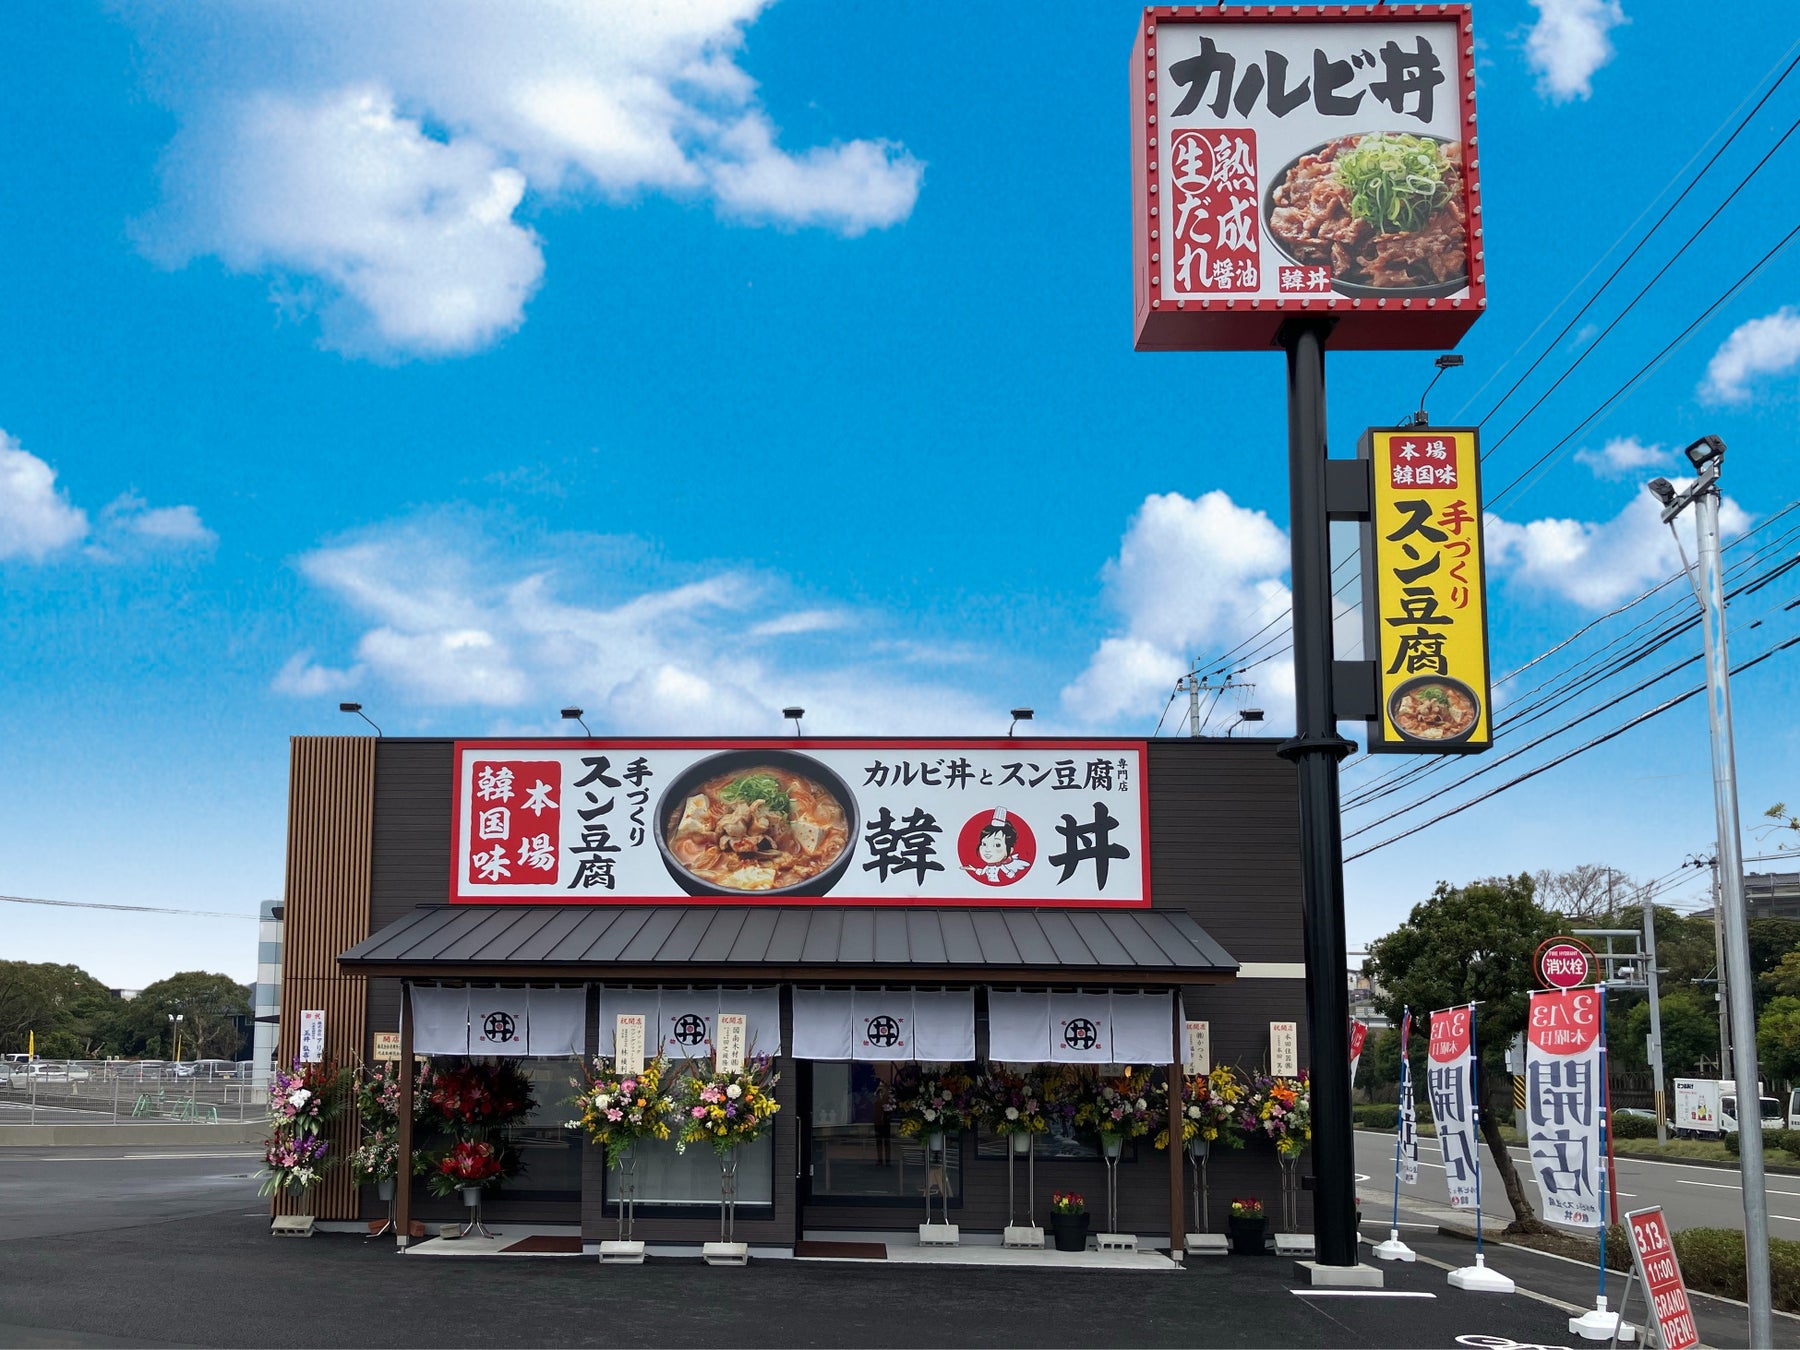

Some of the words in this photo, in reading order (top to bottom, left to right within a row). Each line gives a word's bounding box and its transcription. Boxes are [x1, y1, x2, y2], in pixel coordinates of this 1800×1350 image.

[1168, 35, 1446, 124] カルビ丼
[1174, 135, 1213, 291] 生だれ
[1213, 134, 1257, 252] 熟成
[1213, 259, 1258, 290] 醤油
[1281, 268, 1331, 292] 韓丼
[1392, 464, 1457, 485] 韓国味
[1400, 441, 1447, 461] 本場
[1437, 499, 1475, 610] 手づくり
[1385, 499, 1454, 676] スン豆腐
[622, 757, 653, 848] 手づくり
[862, 757, 1114, 791] カルビ丼とスン豆腐
[1117, 758, 1129, 792] 専門店
[472, 765, 515, 882] 韓国味
[517, 779, 560, 871] 本場
[567, 755, 622, 890] スン豆腐
[862, 806, 945, 887] 韓
[1048, 801, 1131, 891] 丼
[1546, 958, 1583, 974] 消火栓
[1648, 1258, 1674, 1283] 11:00
[1655, 1288, 1685, 1320] GRAND
[1662, 1313, 1694, 1349] OPEN!
